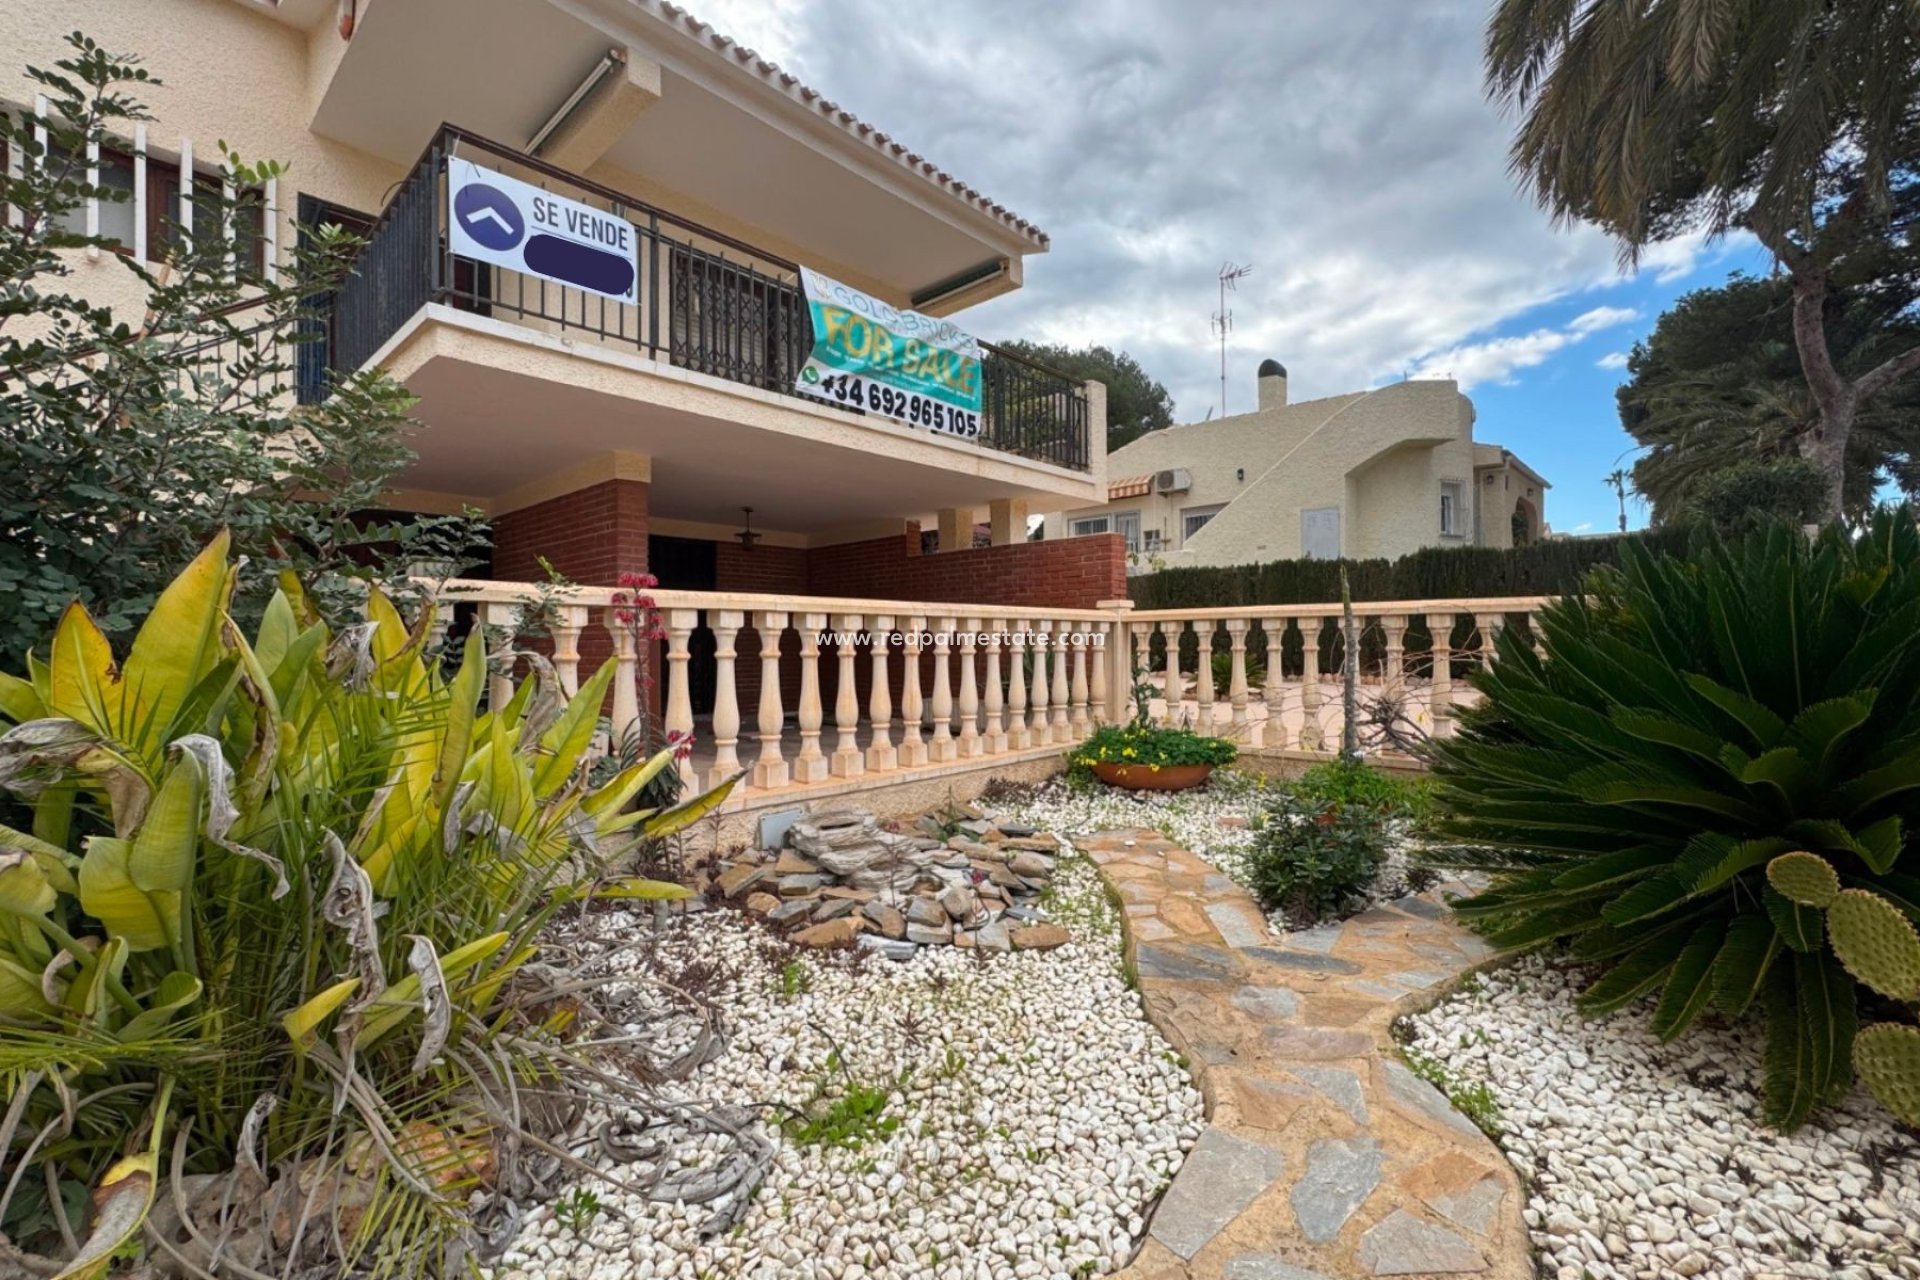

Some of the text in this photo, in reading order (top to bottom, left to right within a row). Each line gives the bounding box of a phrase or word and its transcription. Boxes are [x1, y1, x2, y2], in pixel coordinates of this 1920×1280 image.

[533, 197, 629, 251] SE VENDE
[822, 306, 894, 369] FOR
[903, 338, 976, 395] SALE
[822, 374, 865, 407] +34
[869, 383, 907, 419] 692
[910, 396, 944, 430] 965
[947, 408, 977, 437] 105
